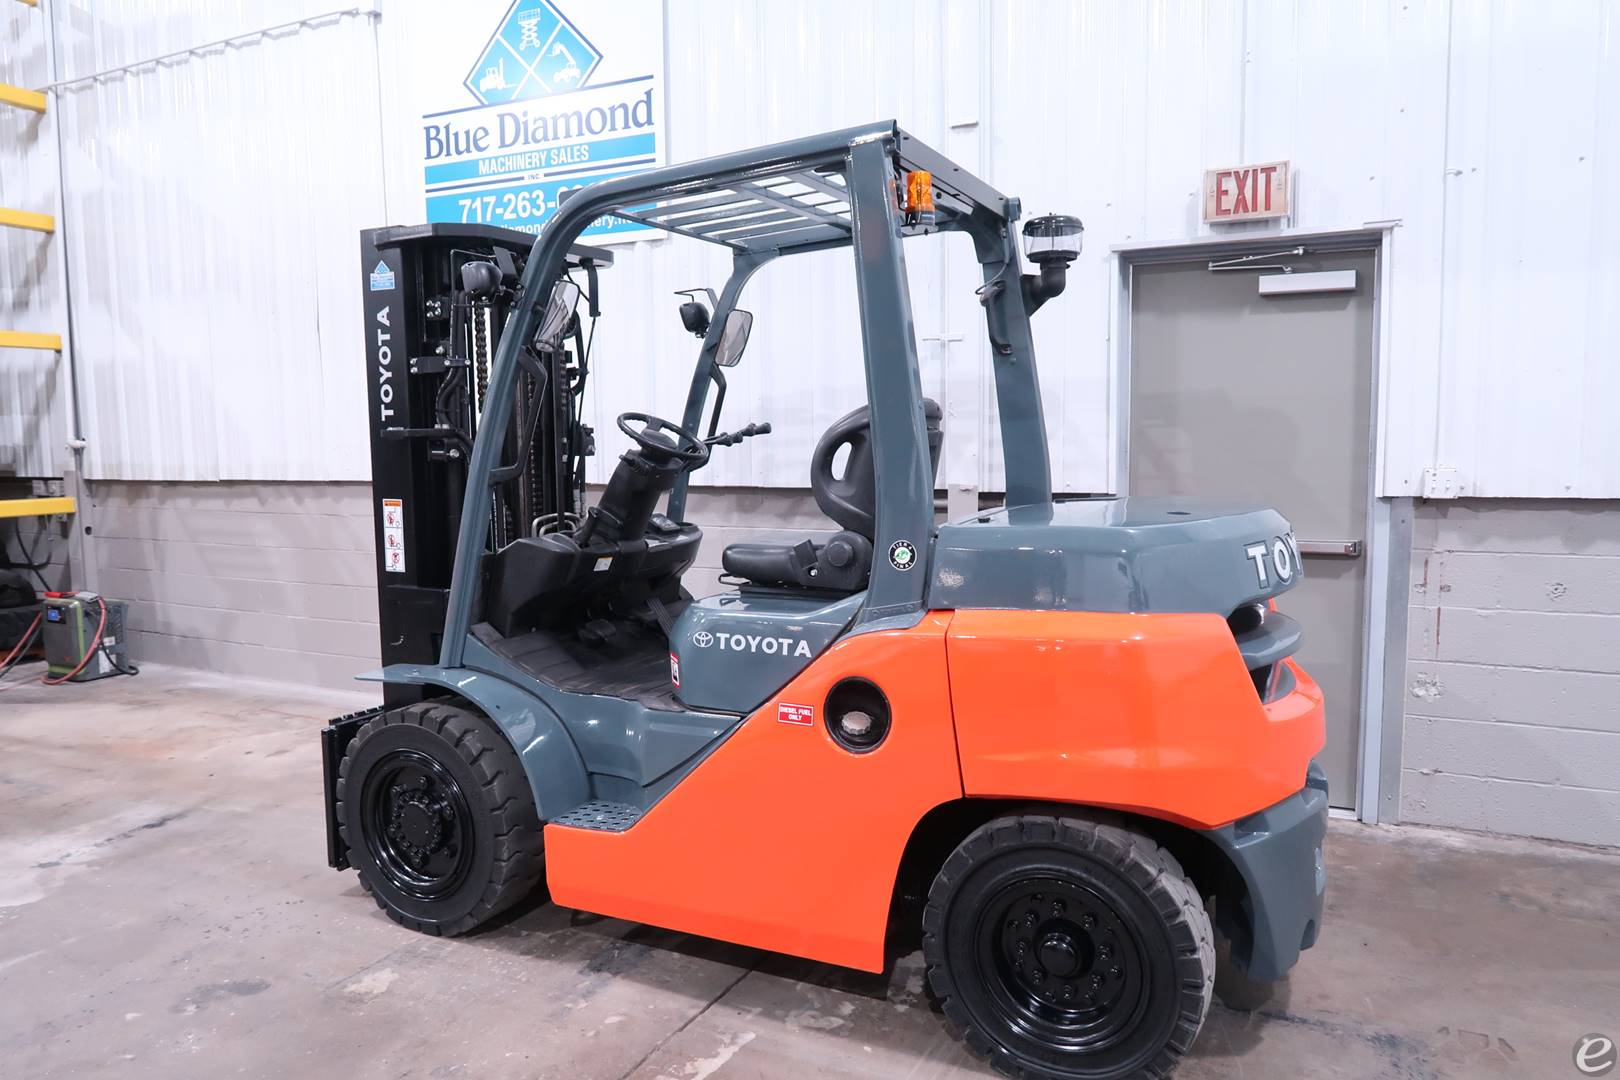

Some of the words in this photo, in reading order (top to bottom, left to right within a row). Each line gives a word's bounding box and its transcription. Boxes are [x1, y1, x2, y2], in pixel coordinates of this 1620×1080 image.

[423, 122, 490, 160] Blue
[497, 87, 655, 149] Diamond
[478, 151, 548, 176] MACHINERY
[551, 145, 590, 165] SALES
[458, 184, 584, 224] 717-263-
[1215, 166, 1277, 217] EXIT
[376, 305, 395, 422] TOYOTA
[716, 632, 812, 658] TOYOTA
[780, 706, 797, 714] DIESEL
[798, 708, 812, 716] FUEL
